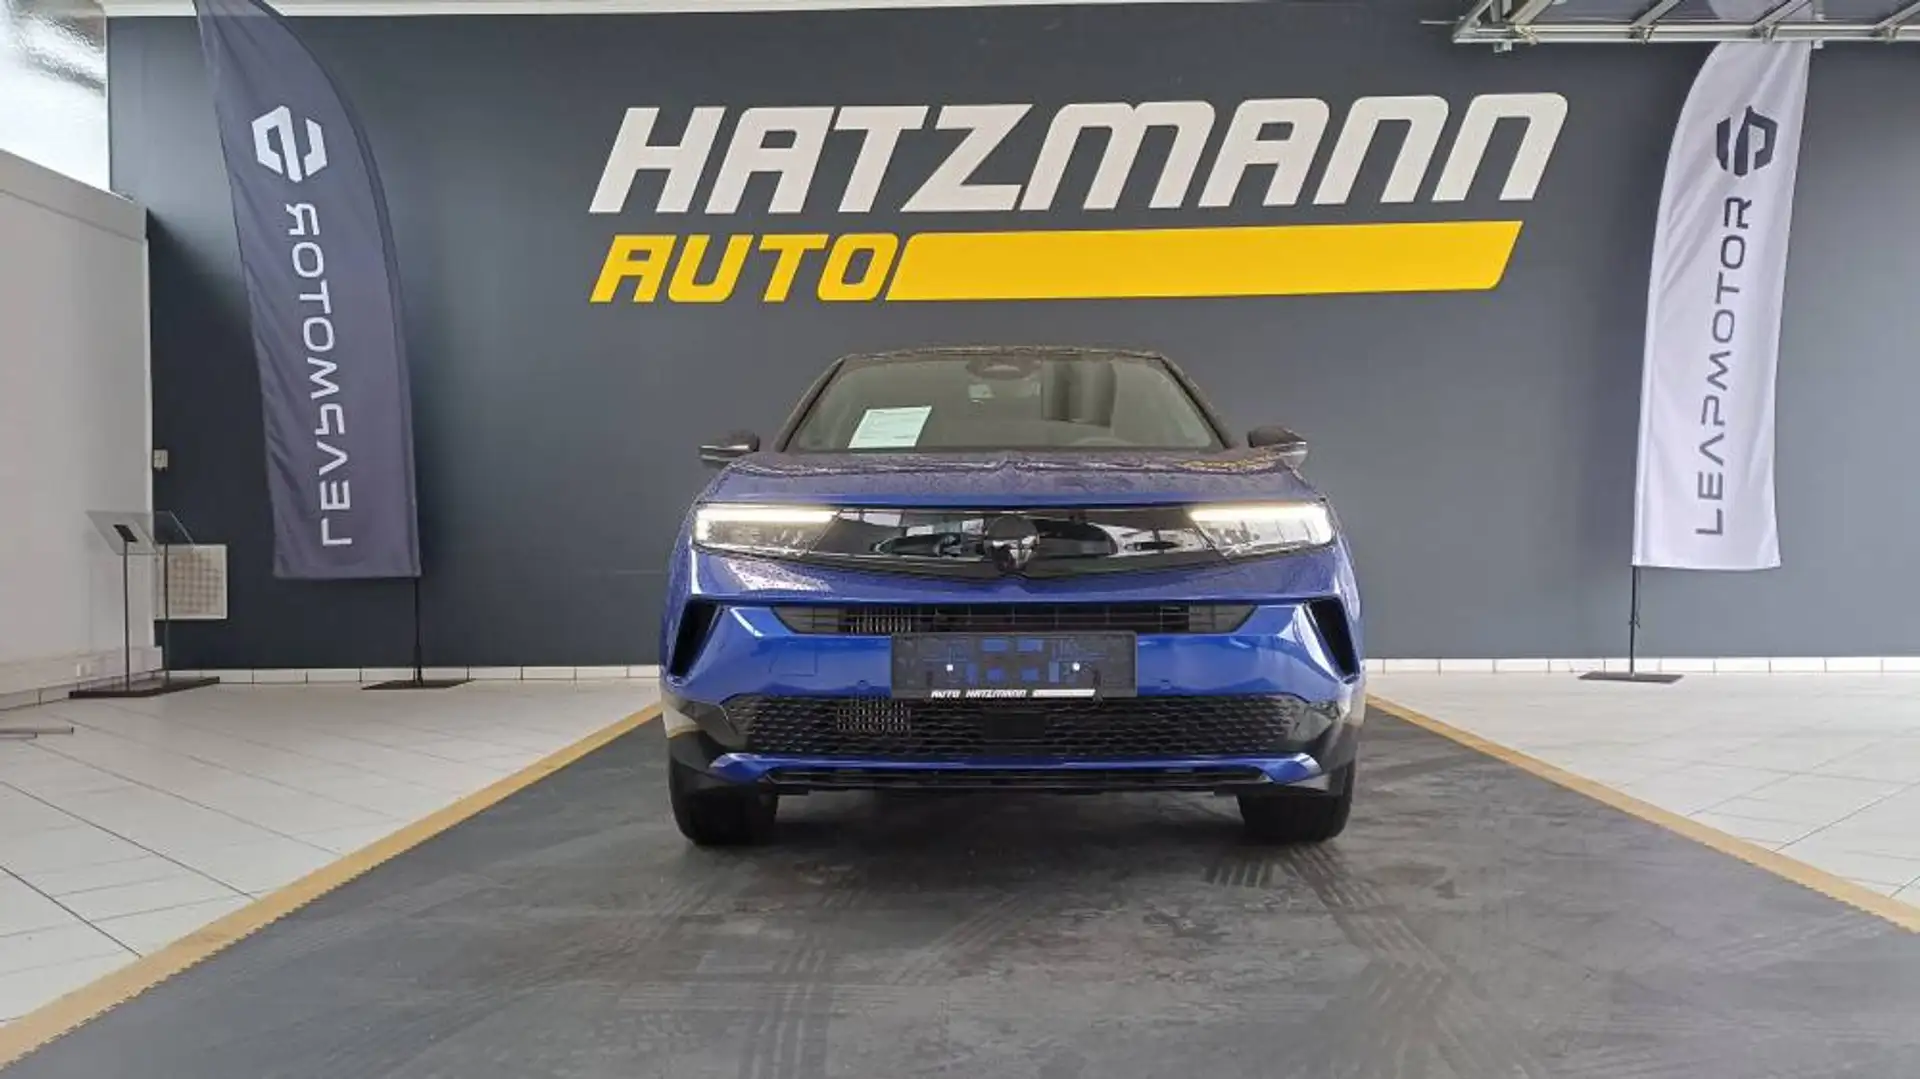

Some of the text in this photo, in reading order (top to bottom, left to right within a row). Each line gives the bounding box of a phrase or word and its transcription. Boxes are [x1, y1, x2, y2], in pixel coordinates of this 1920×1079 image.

[589, 92, 1569, 214] HATZMANN
[589, 233, 899, 303] AUTO
[1695, 196, 1753, 536] LEAPMOTOR
[931, 688, 1027, 699] AUTO HATZMANN
